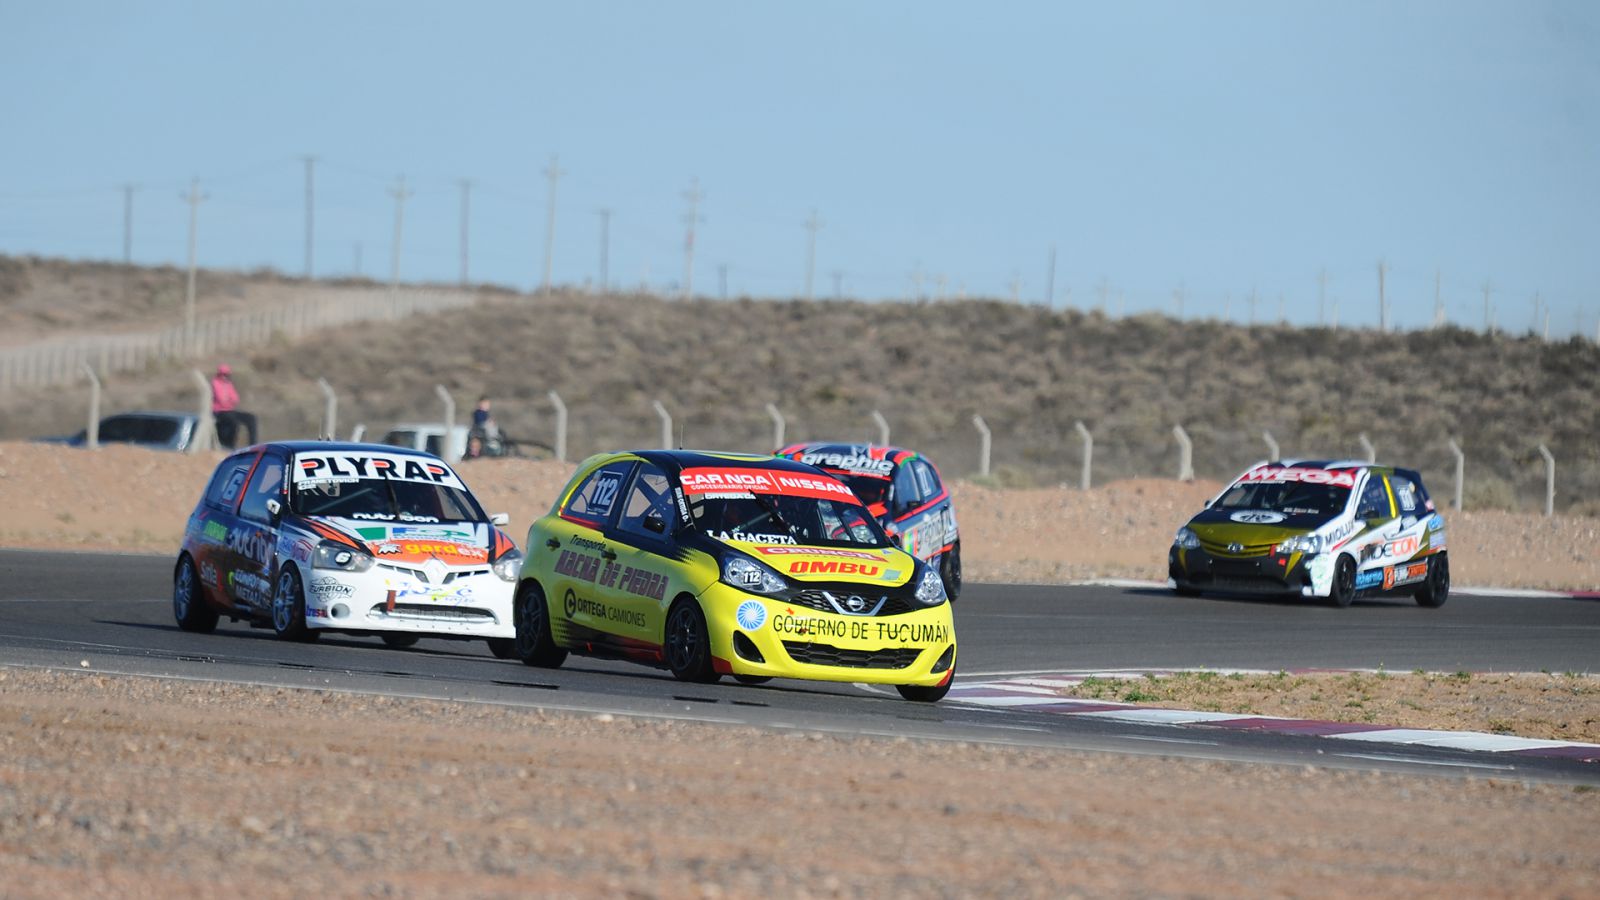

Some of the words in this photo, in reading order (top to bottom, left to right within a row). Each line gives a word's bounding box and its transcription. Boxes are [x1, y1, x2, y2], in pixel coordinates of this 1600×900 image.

[300, 457, 450, 482] PLYRAP
[801, 453, 895, 471] graphic
[680, 474, 723, 485] CAR
[725, 474, 770, 485] NOA
[780, 476, 853, 496] NISSAN
[593, 477, 618, 505] 112
[733, 532, 798, 545] GACETA
[599, 562, 621, 588] DE
[618, 566, 669, 601] PIEDRA
[743, 571, 761, 585] 112
[577, 598, 607, 619] ORTEGA
[608, 607, 645, 627] CAMIONES
[773, 614, 846, 638] GOBIERNO
[851, 621, 869, 640] DE
[876, 620, 949, 644] TUCUMÁN
